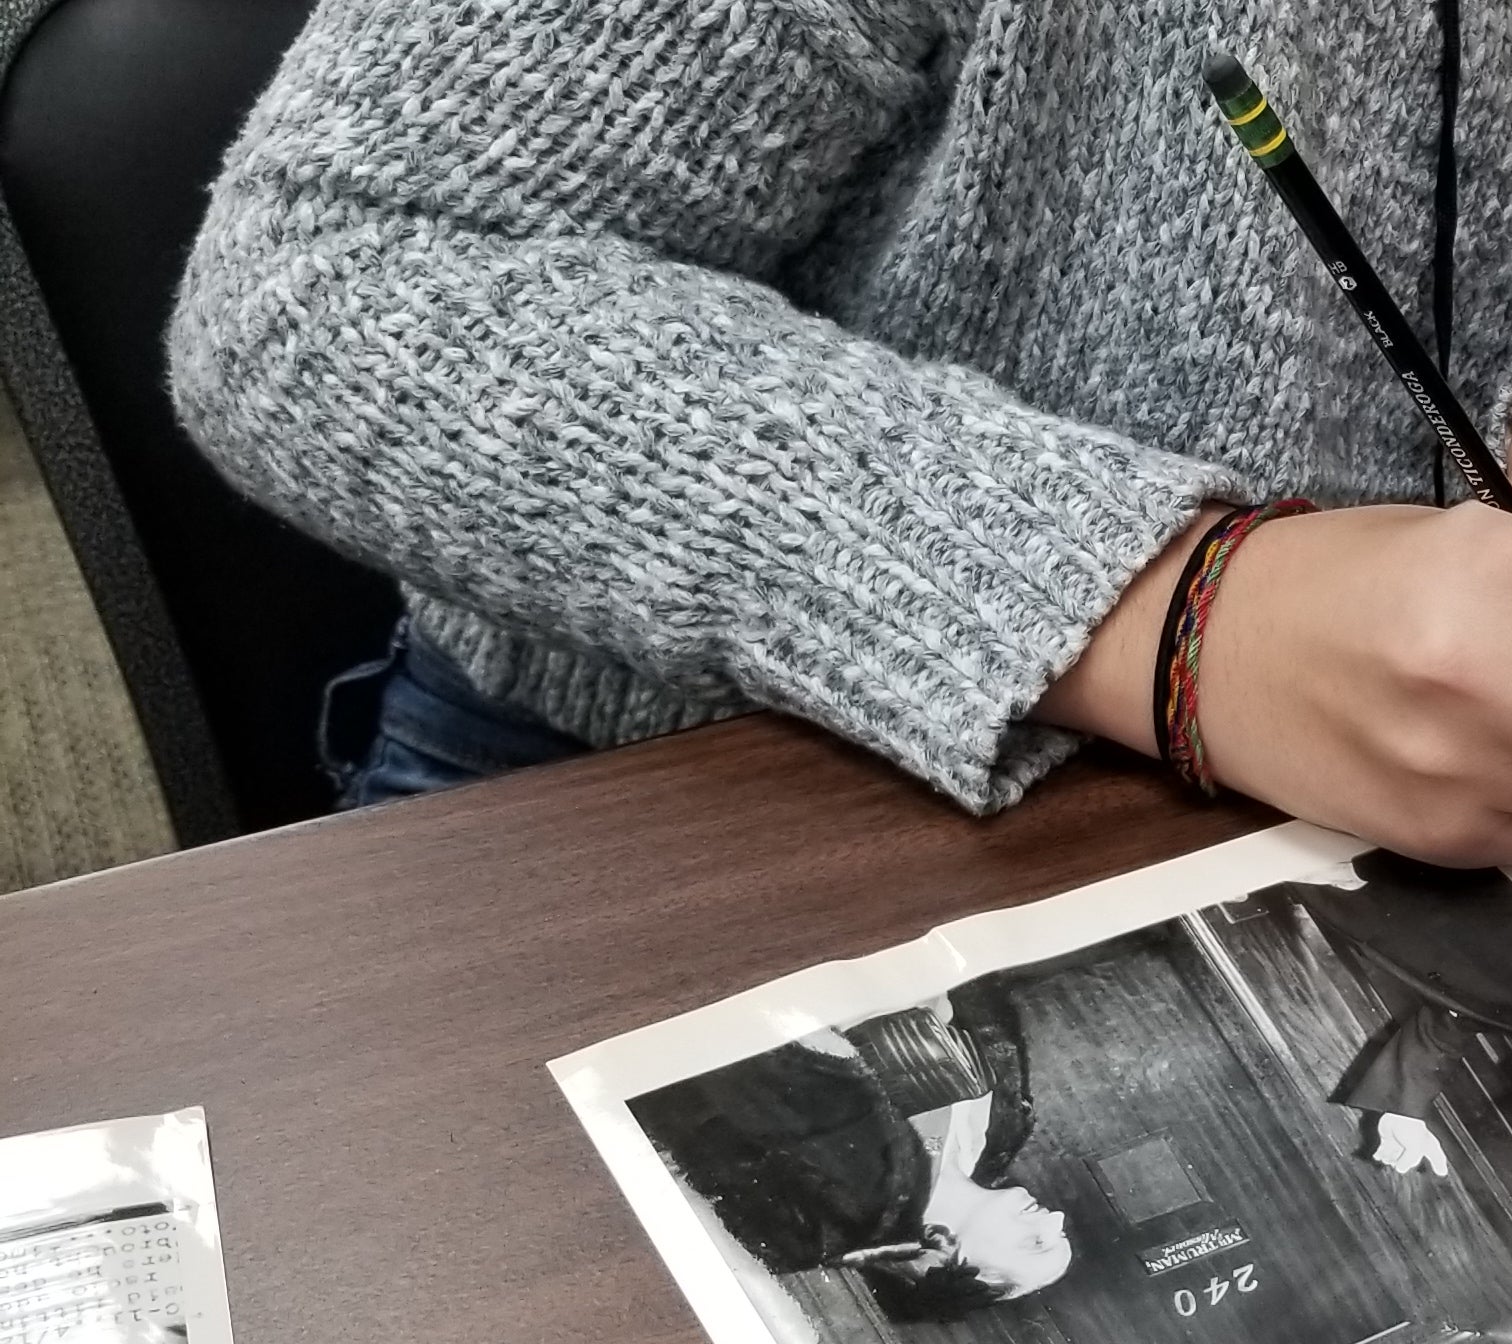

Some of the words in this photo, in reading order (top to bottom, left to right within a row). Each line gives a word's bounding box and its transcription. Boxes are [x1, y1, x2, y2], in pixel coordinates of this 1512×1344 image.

[1328, 261, 1348, 275] HB
[1363, 310, 1394, 348] BLACK
[1402, 371, 1484, 486] TICONDEROGA
[1174, 1263, 1259, 1316] 240
